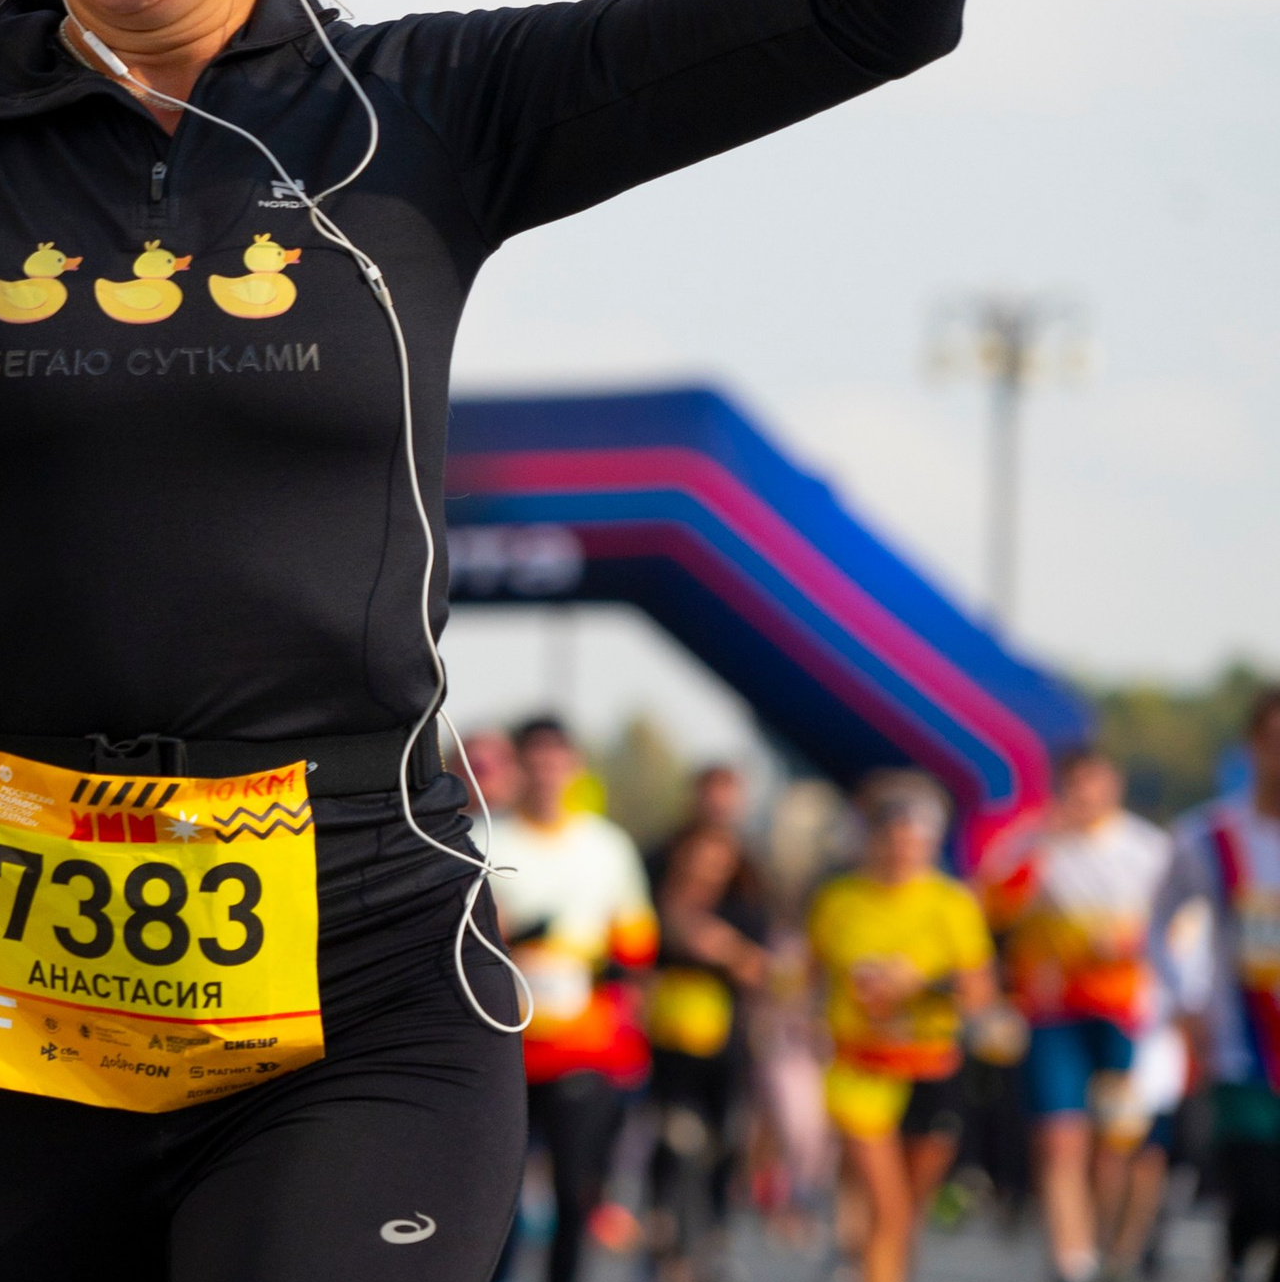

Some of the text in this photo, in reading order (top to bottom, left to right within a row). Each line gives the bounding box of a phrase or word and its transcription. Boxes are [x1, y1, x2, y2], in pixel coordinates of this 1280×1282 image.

[126, 343, 320, 376] СУТКАМИ
[28, 960, 223, 1009] АНАСТАСИЯ
[223, 1036, 279, 1051] СИБУР
